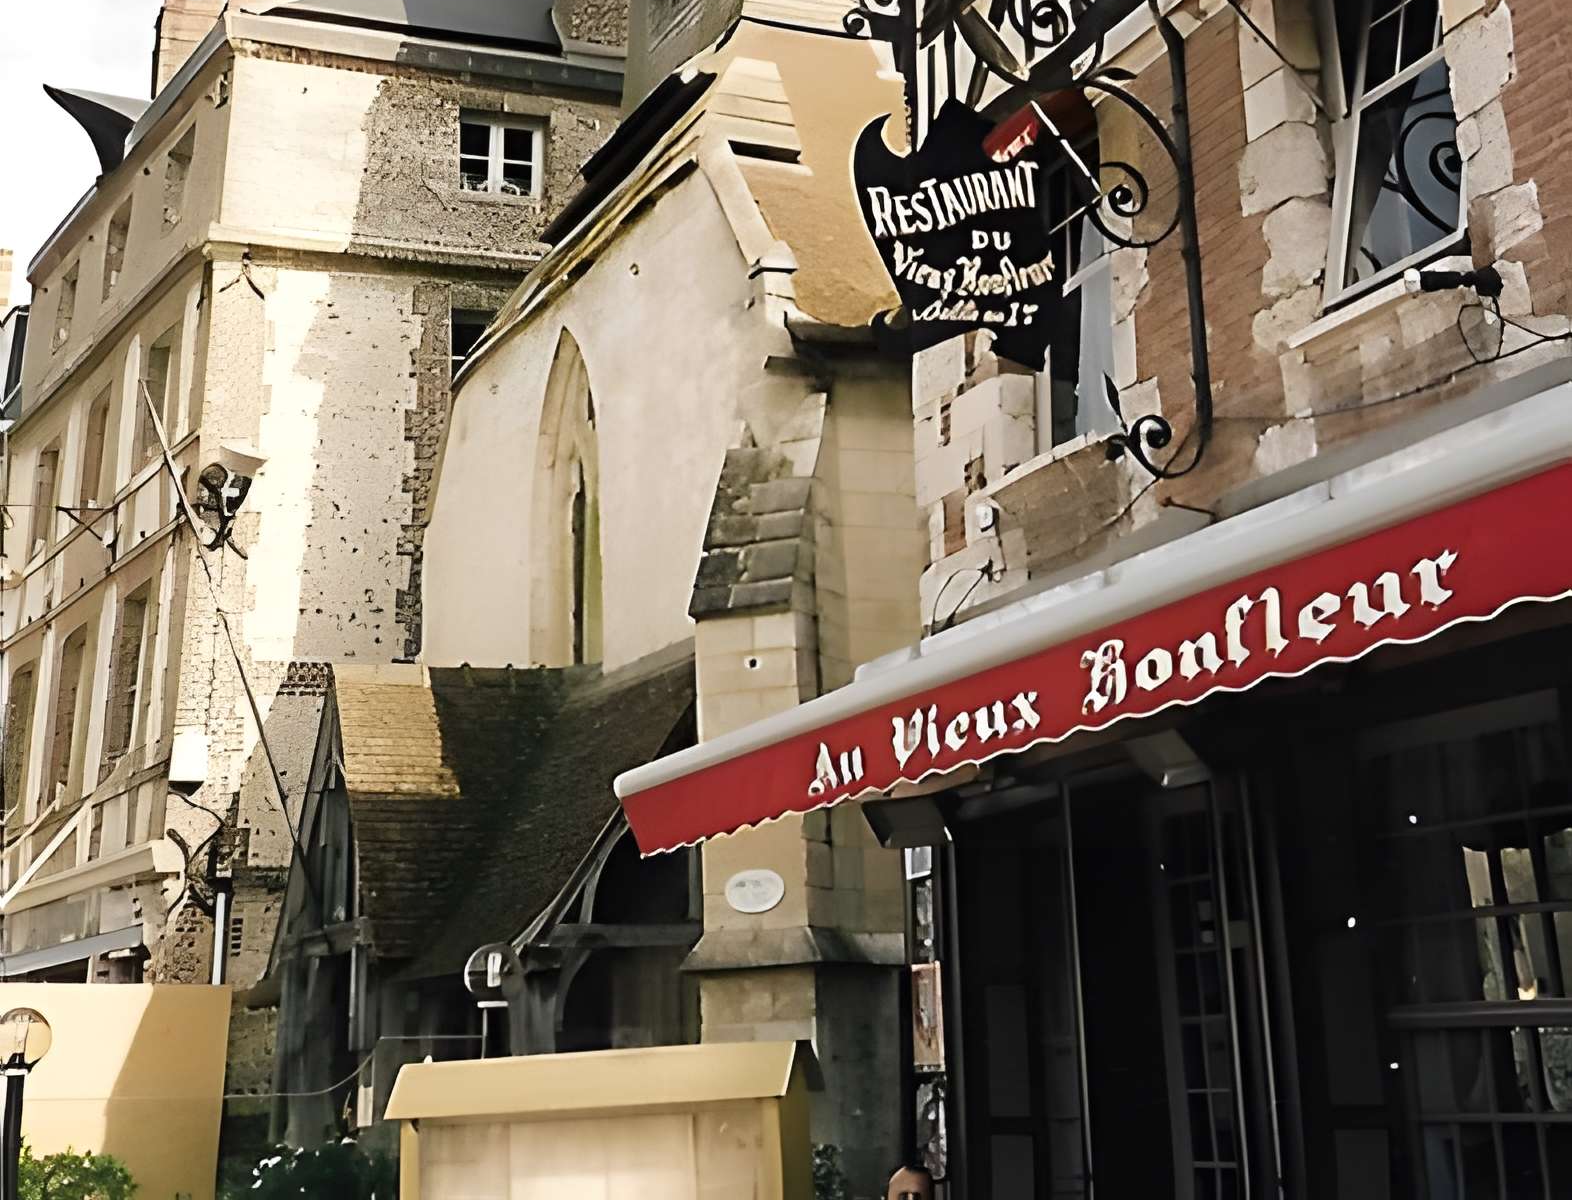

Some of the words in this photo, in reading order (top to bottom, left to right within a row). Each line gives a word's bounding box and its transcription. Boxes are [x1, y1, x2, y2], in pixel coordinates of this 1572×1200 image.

[866, 160, 1039, 238] RESTAURANT
[971, 229, 1012, 251] DU
[807, 741, 865, 797] Au
[891, 690, 1041, 771] Vieux
[1079, 548, 1459, 716] Honfleur
